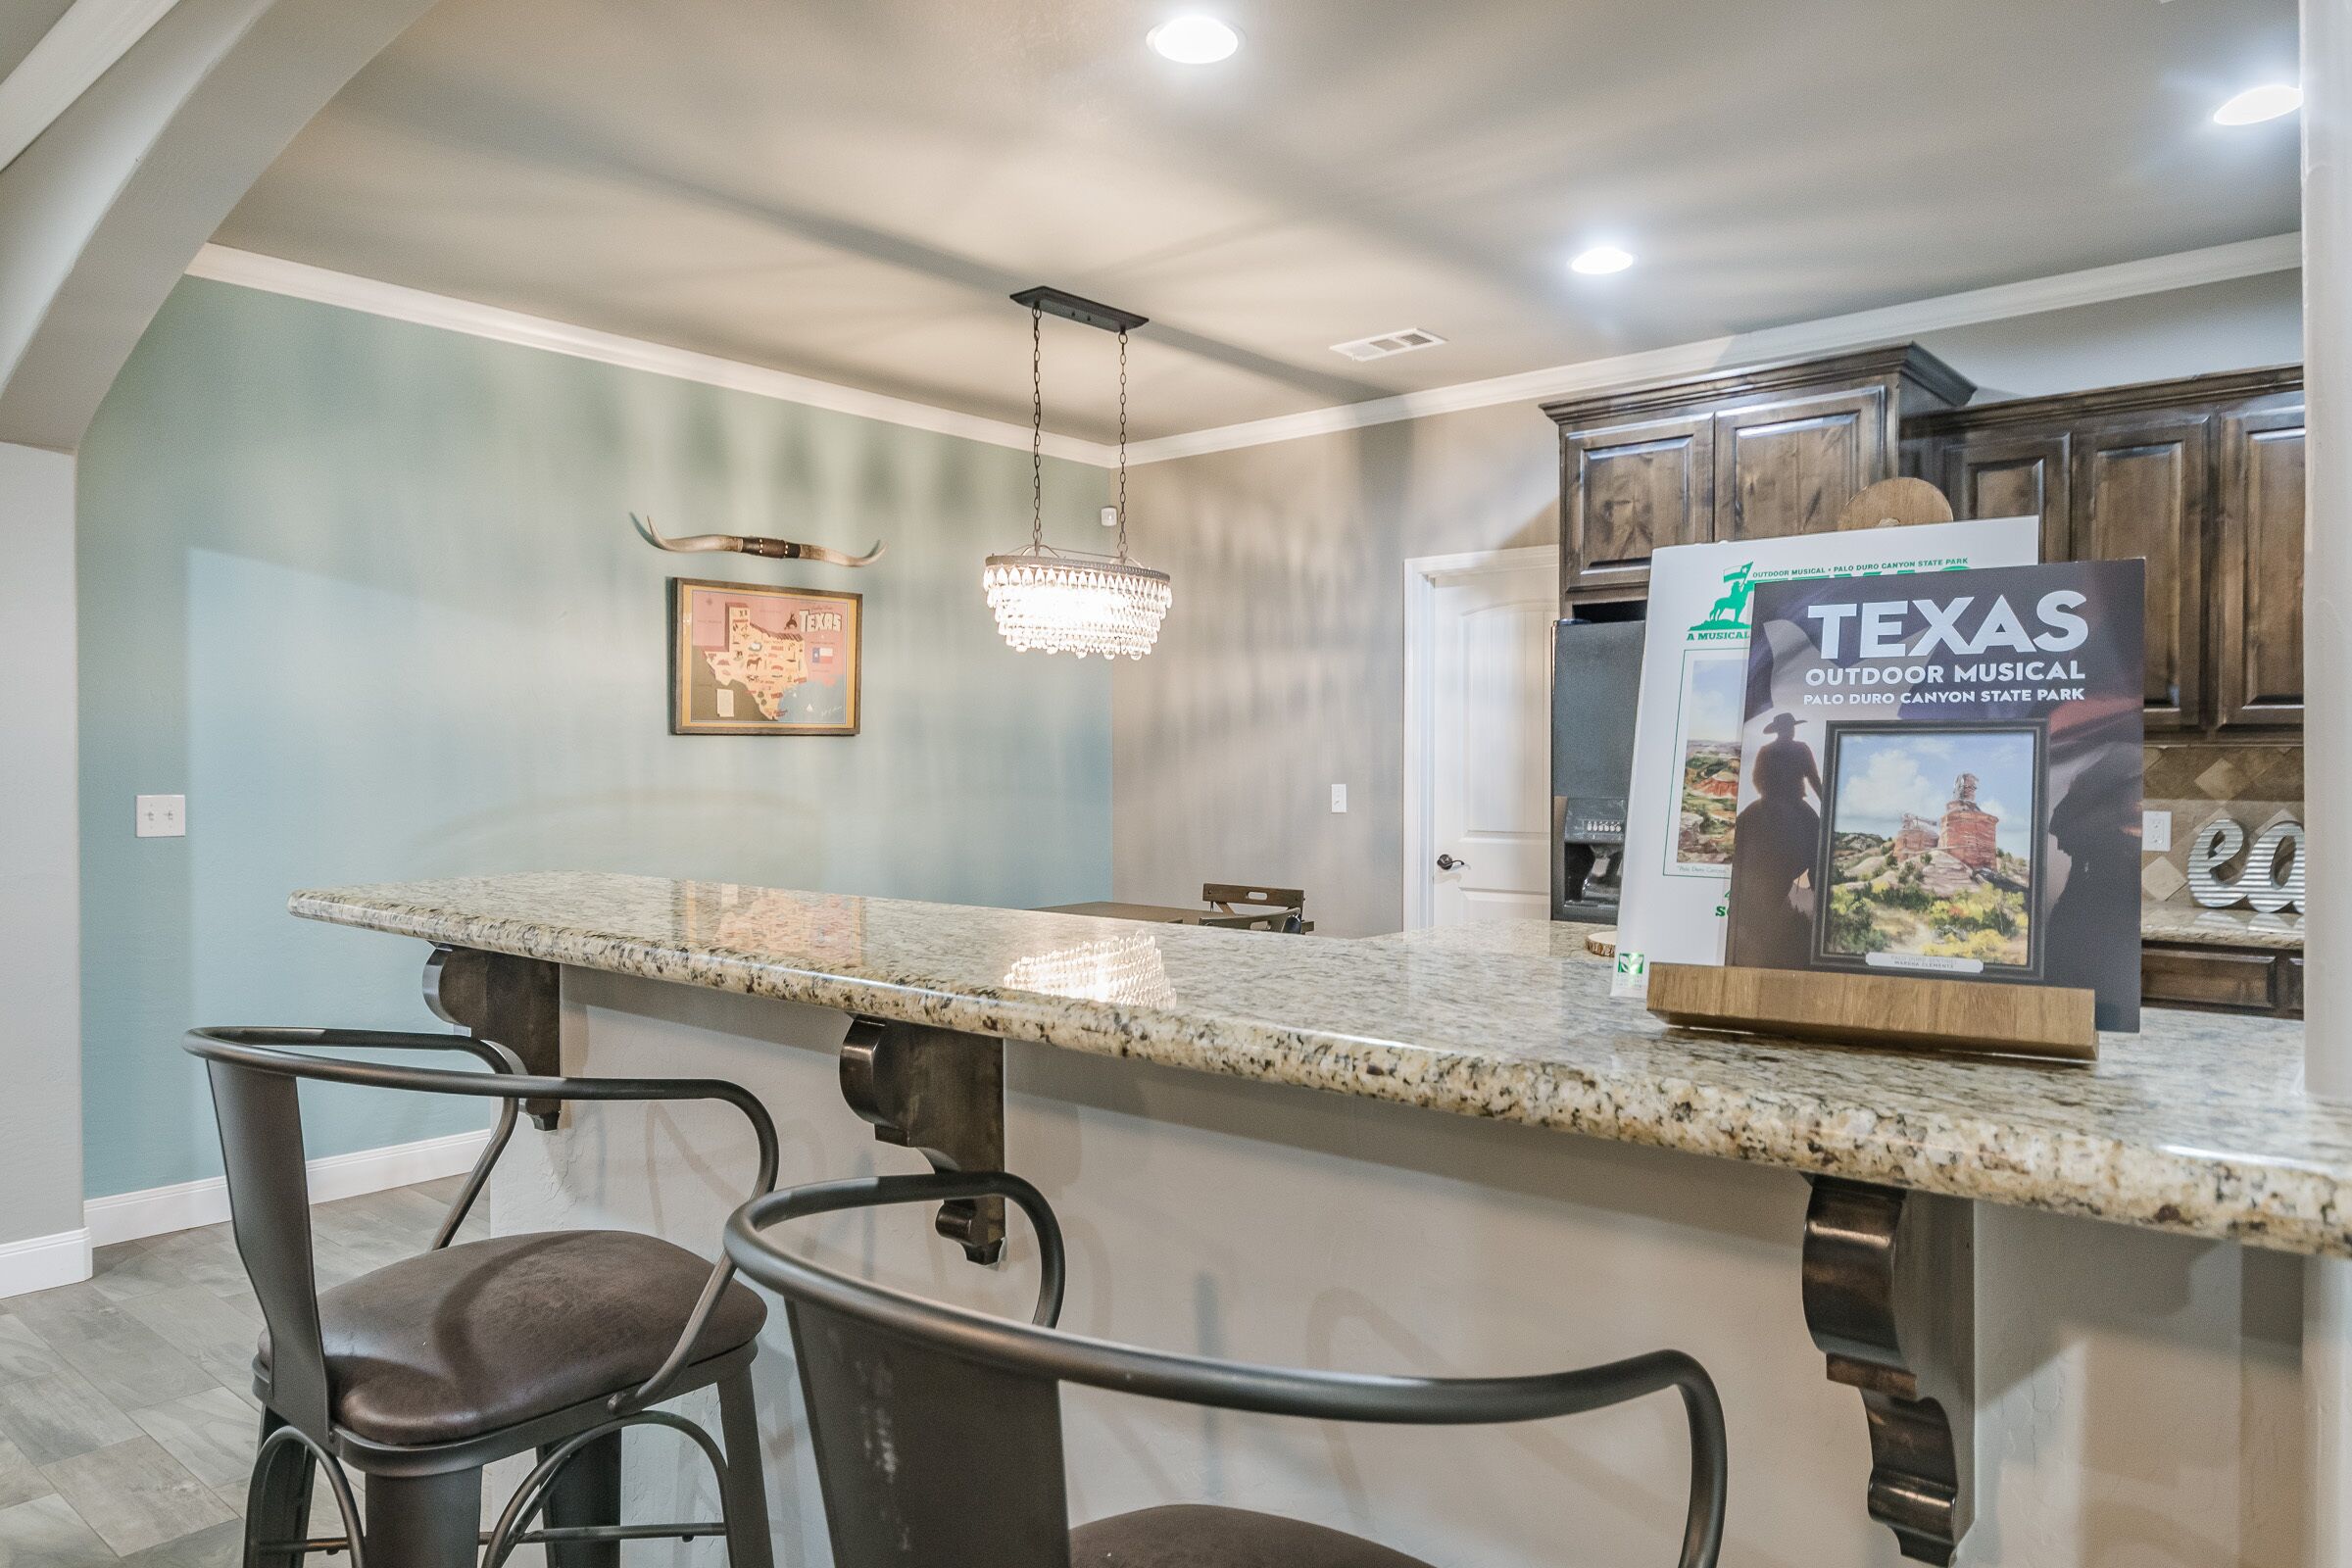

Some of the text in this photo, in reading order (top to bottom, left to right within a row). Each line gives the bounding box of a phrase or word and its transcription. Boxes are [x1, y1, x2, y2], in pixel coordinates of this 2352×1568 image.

[1752, 569, 1789, 578] OUTDOOR
[1791, 566, 1826, 575] MUSICAL
[1881, 561, 1915, 569] CANYON
[799, 609, 842, 633] TEXAS
[1808, 590, 2088, 659] TEXAS
[1687, 631, 1750, 641] A MUSICAL
[1805, 661, 2085, 686] OUTDOOR MUSICAL
[1803, 688, 2085, 705] PALO DURO CANYON STATE PARK
